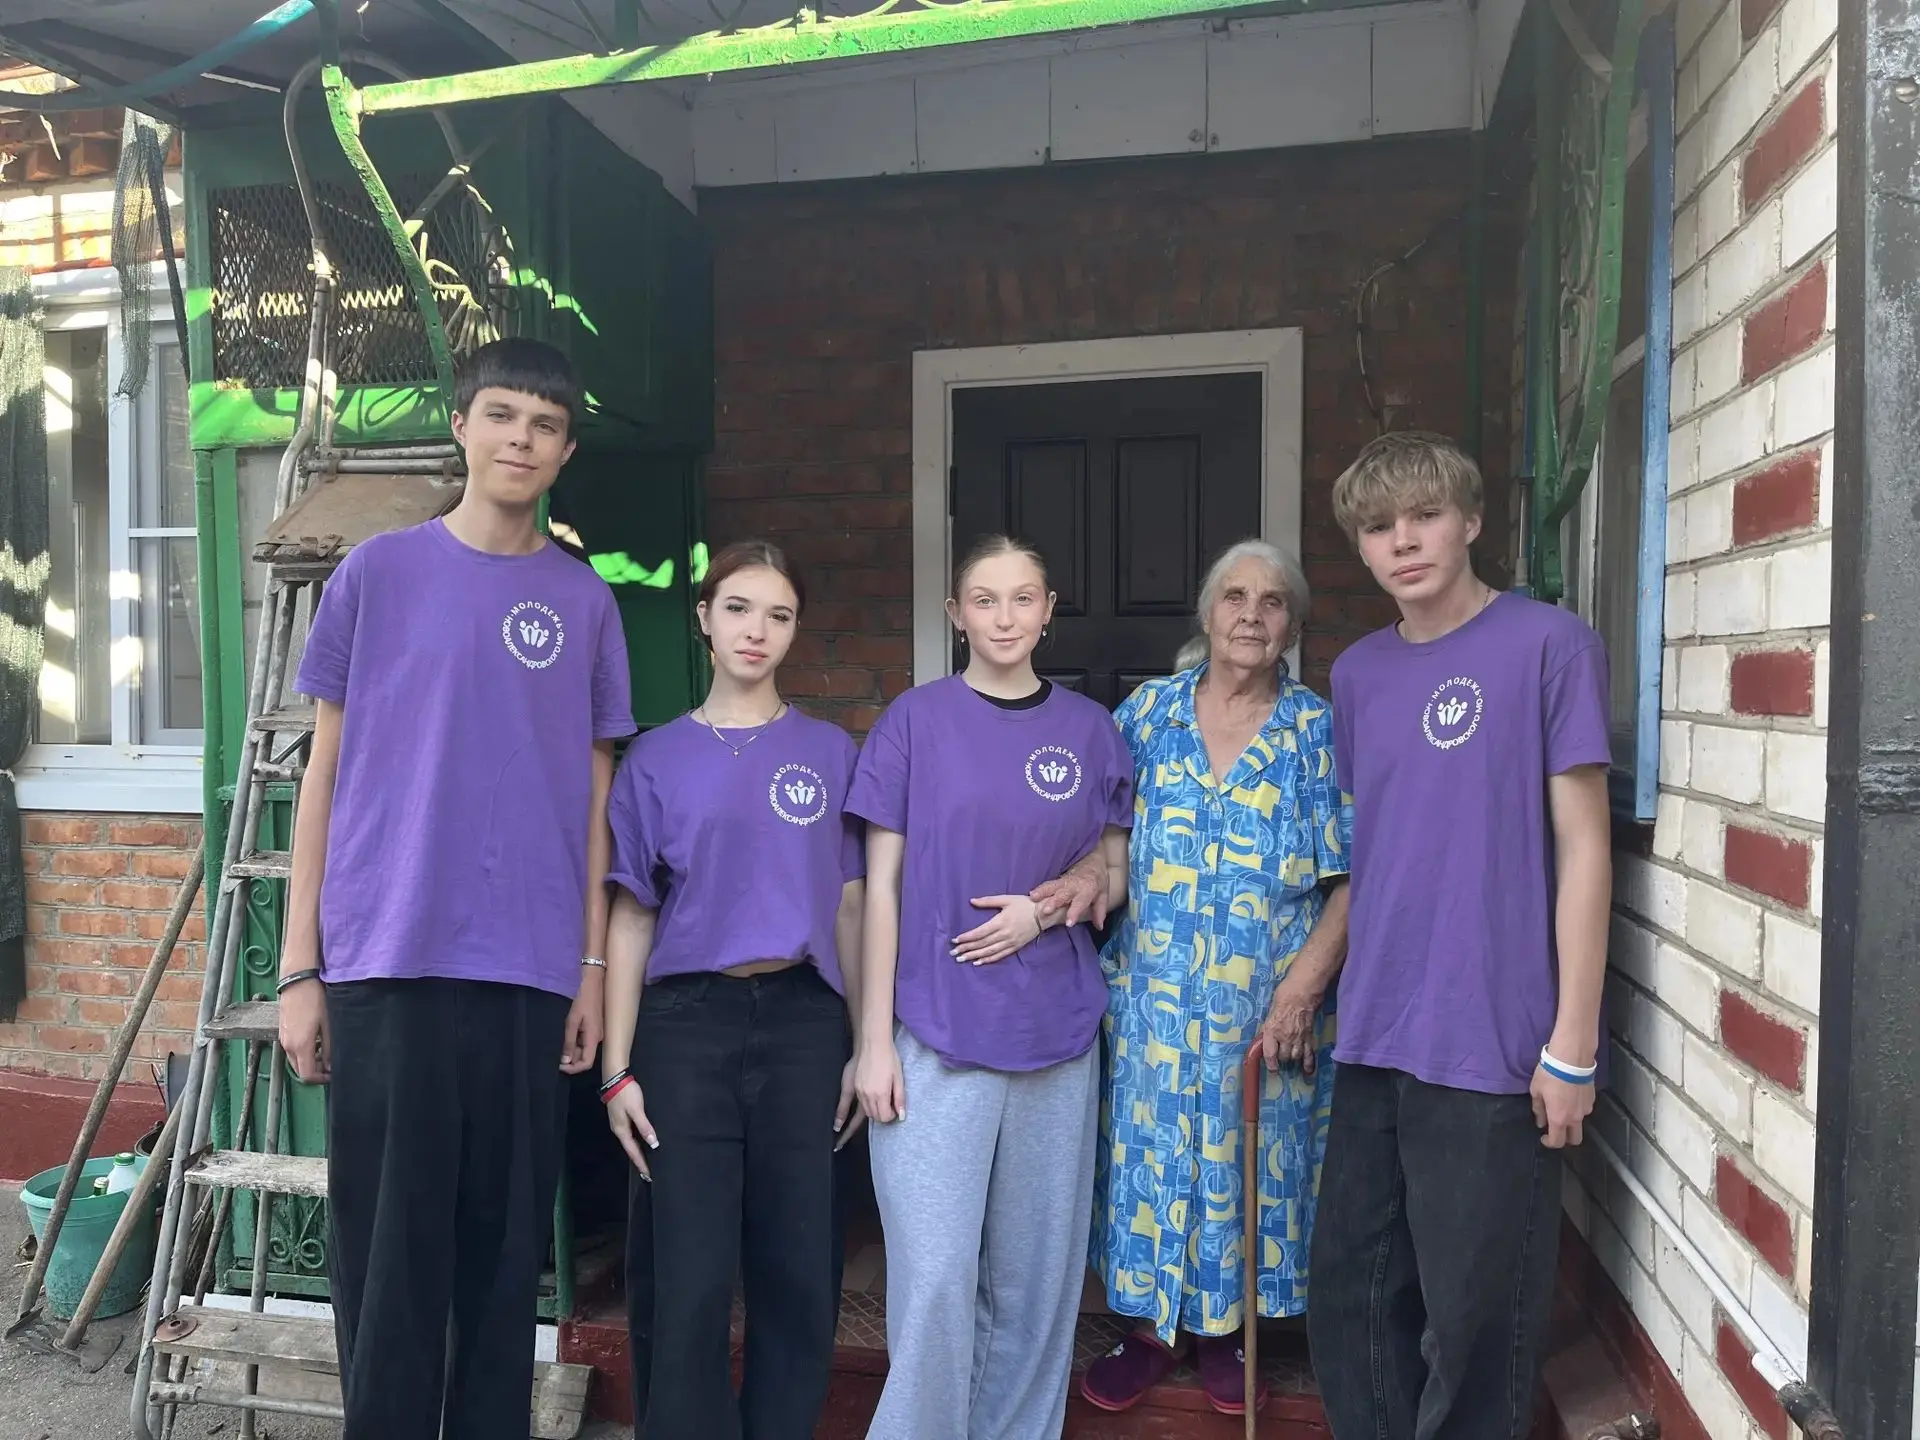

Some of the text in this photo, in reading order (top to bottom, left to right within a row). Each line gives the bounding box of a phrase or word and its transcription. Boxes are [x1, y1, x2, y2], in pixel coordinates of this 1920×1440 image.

[510, 600, 562, 629] МОЛОДЕЖЬ
[1431, 677, 1482, 699] МОЛОДЕЖЬ
[1029, 745, 1078, 763] МОЛОДЕЖЬ
[773, 763, 822, 784] МОЛОДЕЖЬ
